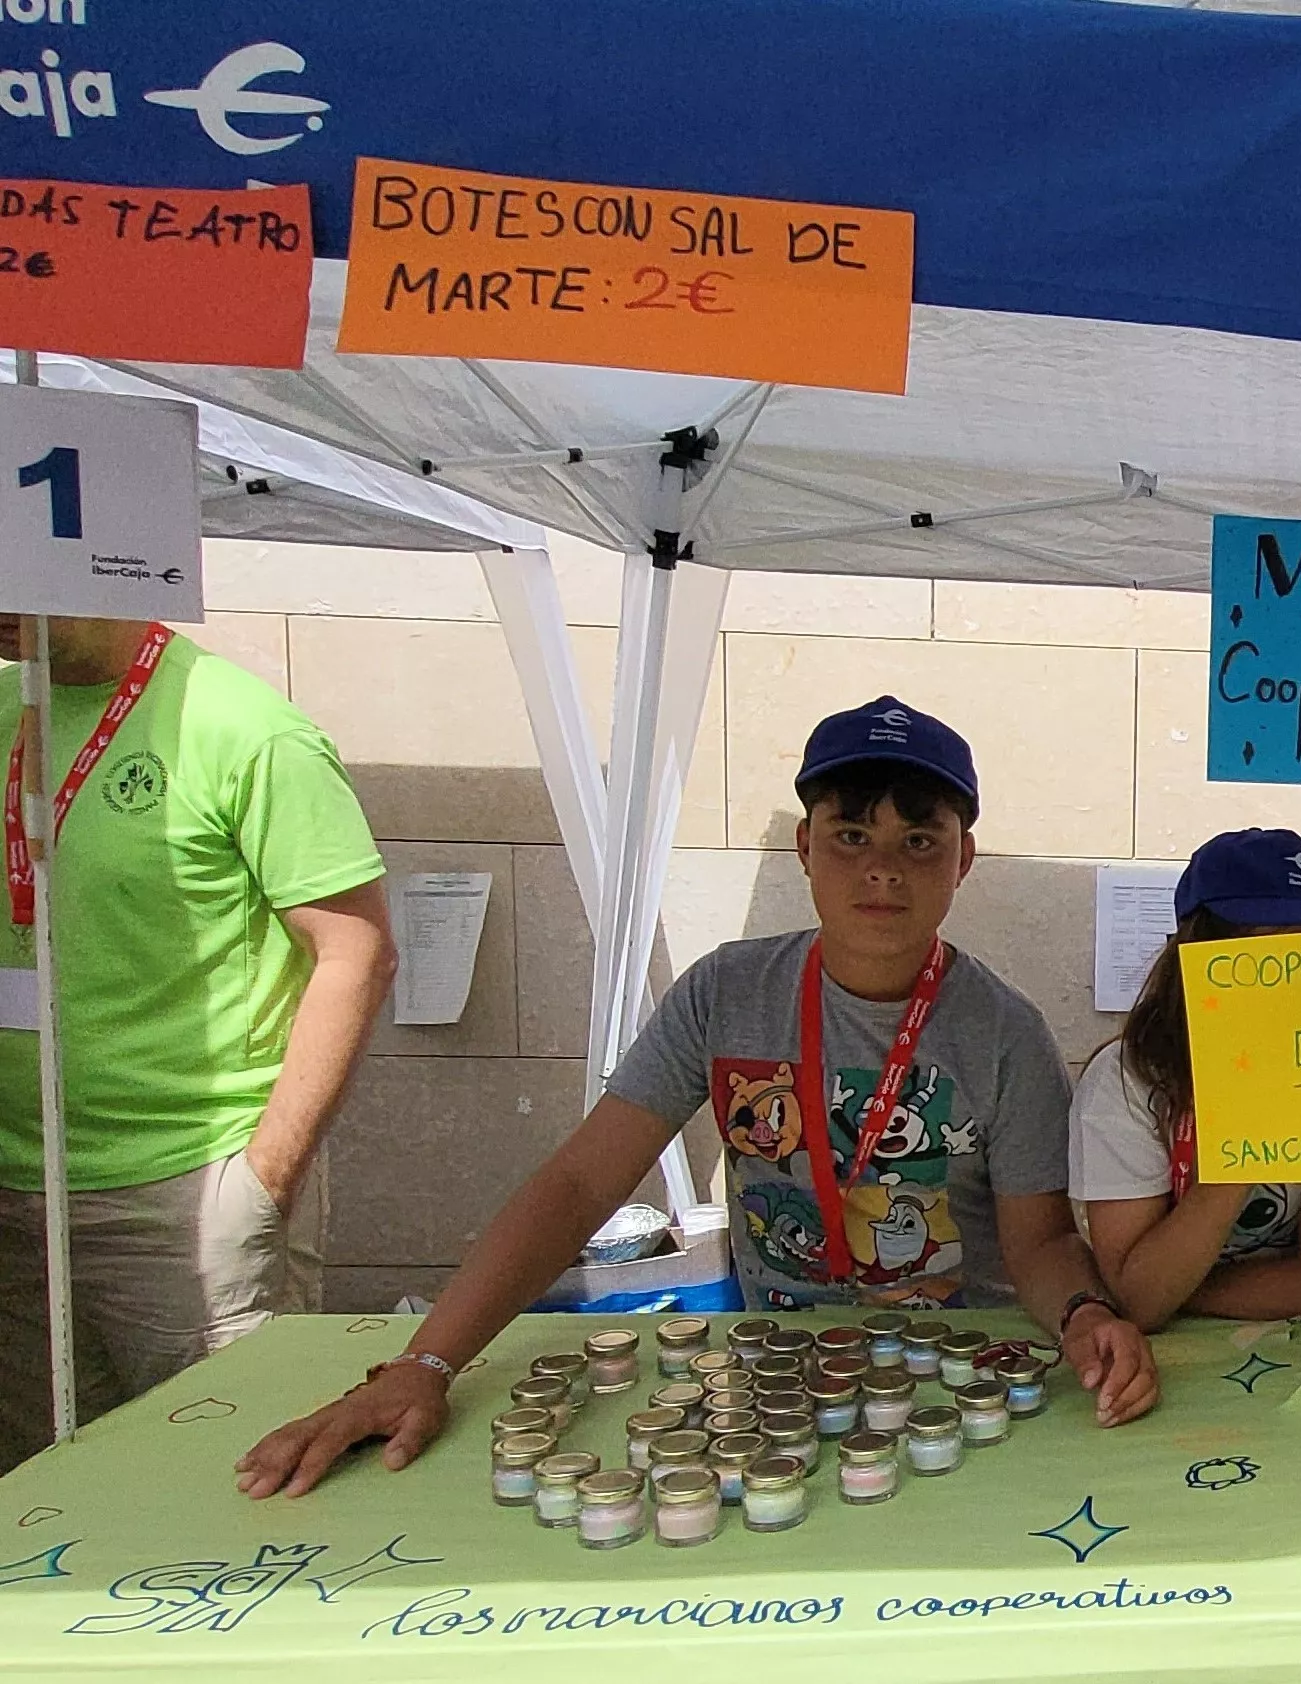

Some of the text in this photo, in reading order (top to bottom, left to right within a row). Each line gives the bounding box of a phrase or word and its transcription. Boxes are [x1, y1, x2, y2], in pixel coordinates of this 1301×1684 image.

[107, 199, 300, 252] TEATRO
[670, 205, 754, 257] SAL
[787, 221, 867, 270] DE
[624, 266, 736, 314] 2€
[361, 1577, 1233, 1638] los marcianos cooperativos
